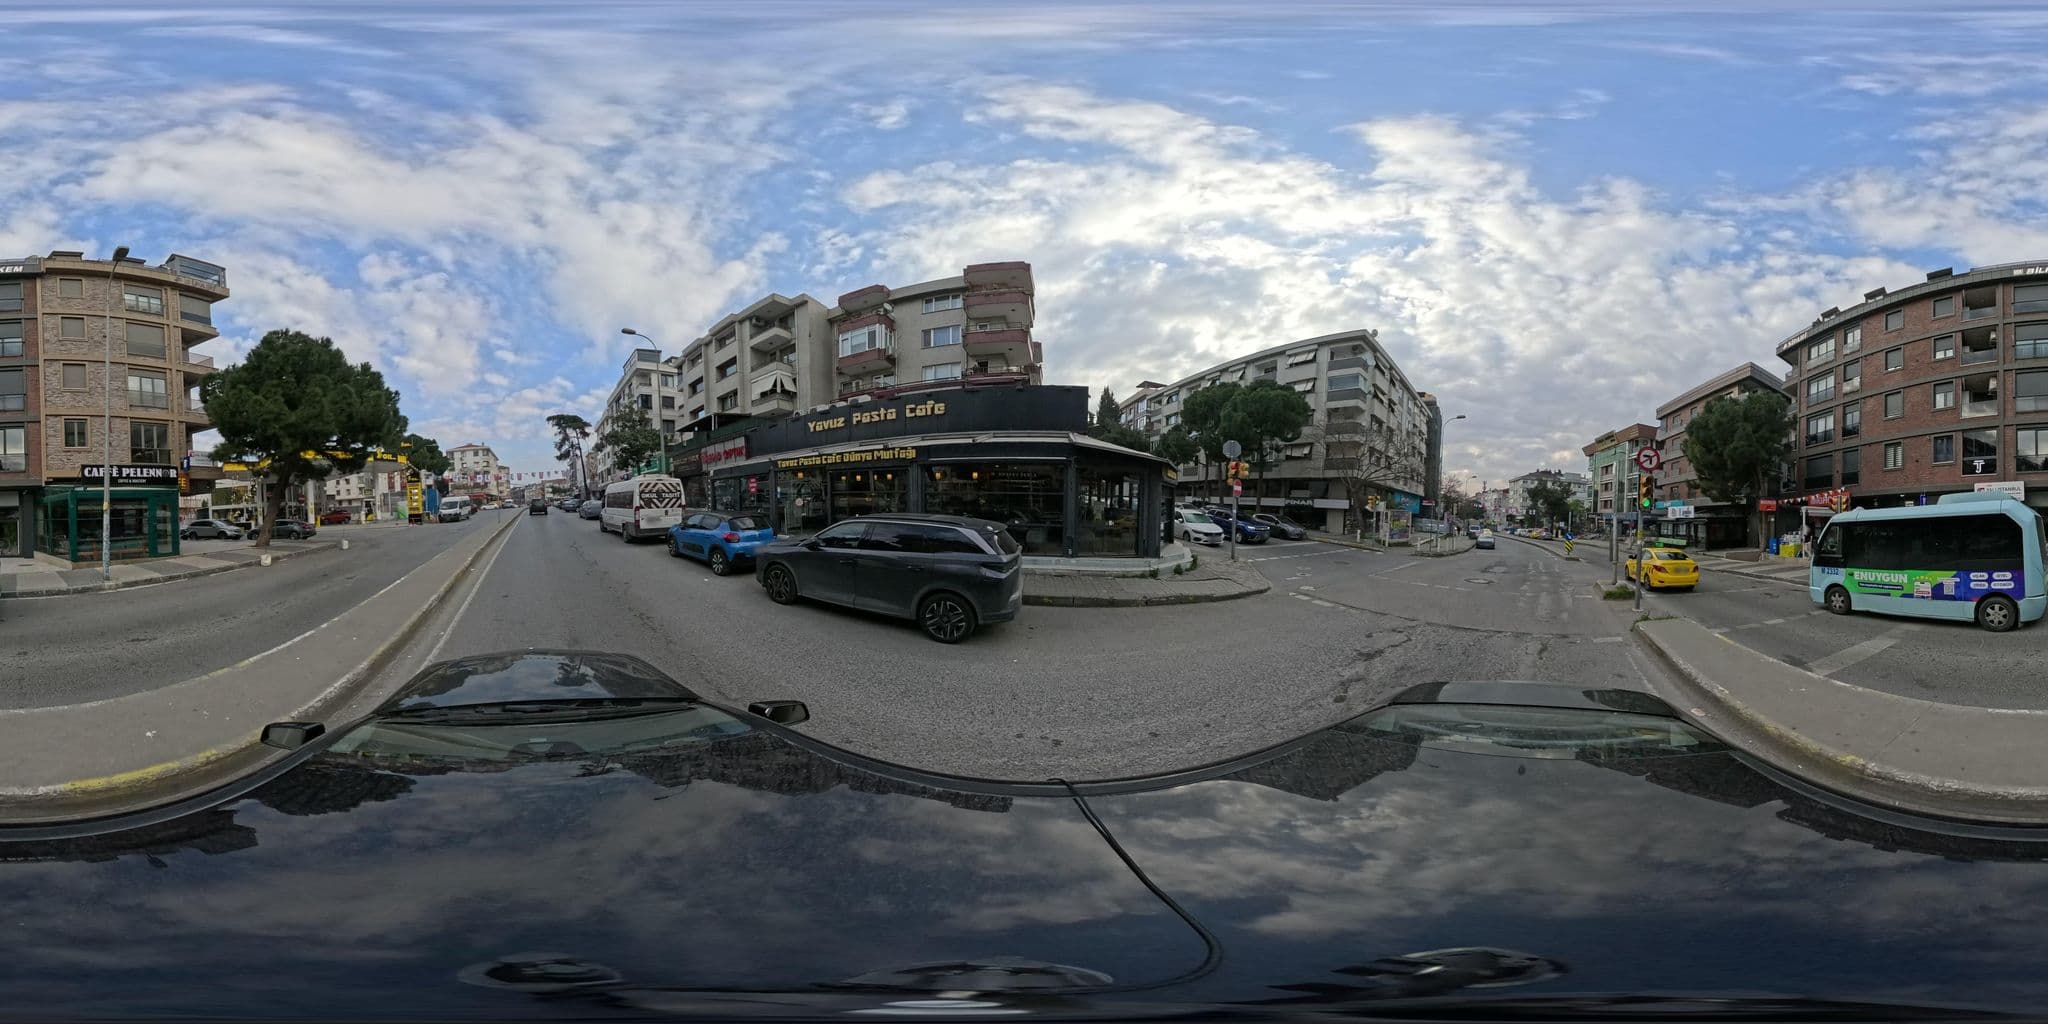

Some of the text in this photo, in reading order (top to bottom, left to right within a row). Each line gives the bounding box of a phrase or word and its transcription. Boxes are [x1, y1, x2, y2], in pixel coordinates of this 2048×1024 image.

[807, 400, 946, 433] Yavuz Pasta Cafe
[777, 458, 798, 469] Yavuz
[799, 456, 821, 466] Pasta
[821, 453, 842, 465] Cafe
[83, 466, 119, 478] CAFÈ
[1853, 571, 1908, 584] ENUYGUN
